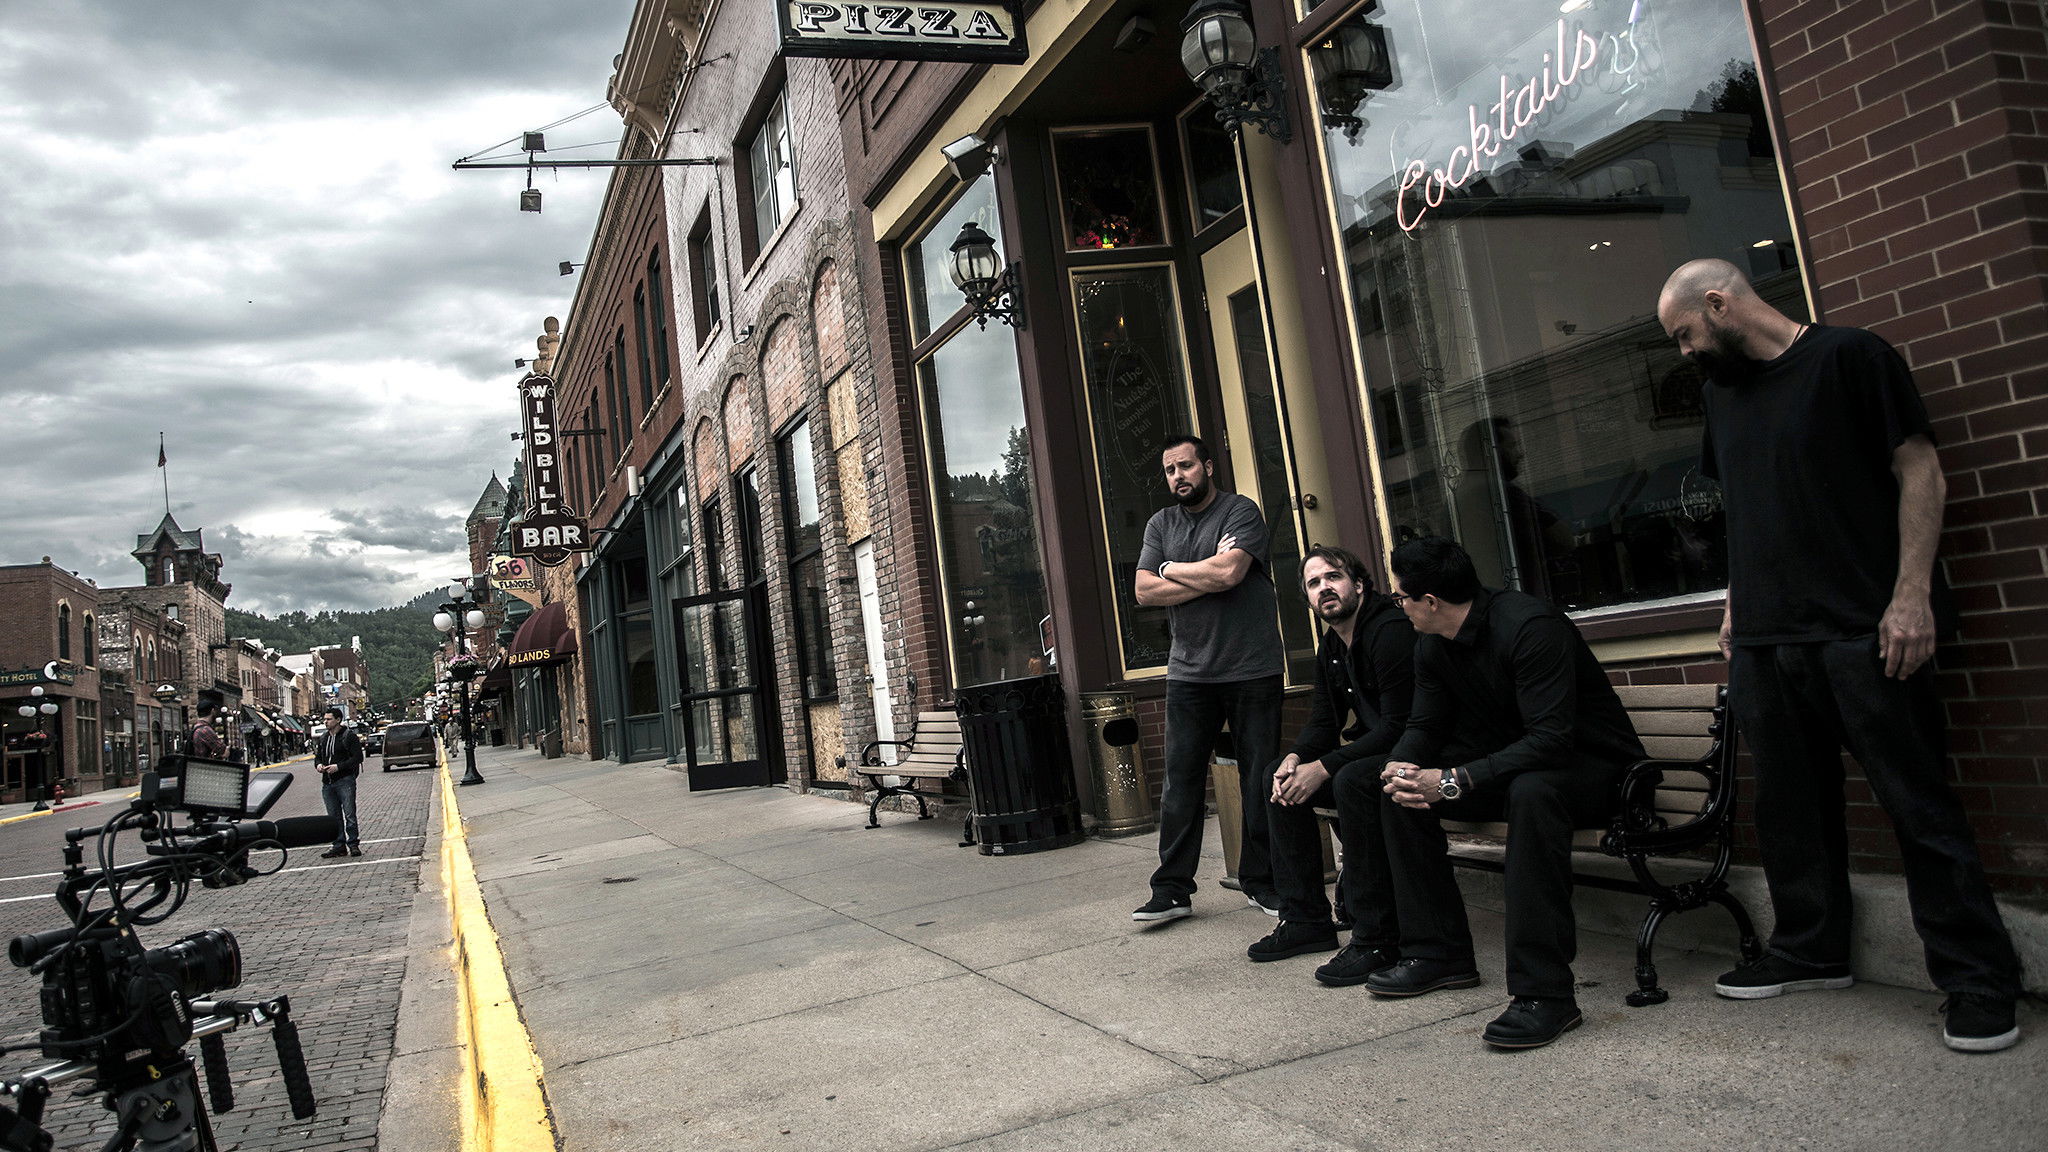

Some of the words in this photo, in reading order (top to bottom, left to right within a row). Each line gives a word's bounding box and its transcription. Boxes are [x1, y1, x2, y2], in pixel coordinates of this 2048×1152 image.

[796, 2, 1008, 40] PIZZA
[1397, 18, 1597, 232] Cocktails
[1116, 366, 1144, 387] The
[1114, 377, 1156, 410] Nugget
[1117, 395, 1160, 431] Gambling
[1131, 418, 1152, 438] Hall
[521, 525, 582, 548] BAR
[495, 560, 523, 576] 56
[498, 579, 534, 589] FLAVORS
[518, 649, 551, 664] LANDS
[11, 673, 38, 681] HOTEL
[170, 990, 187, 1023] Canon
